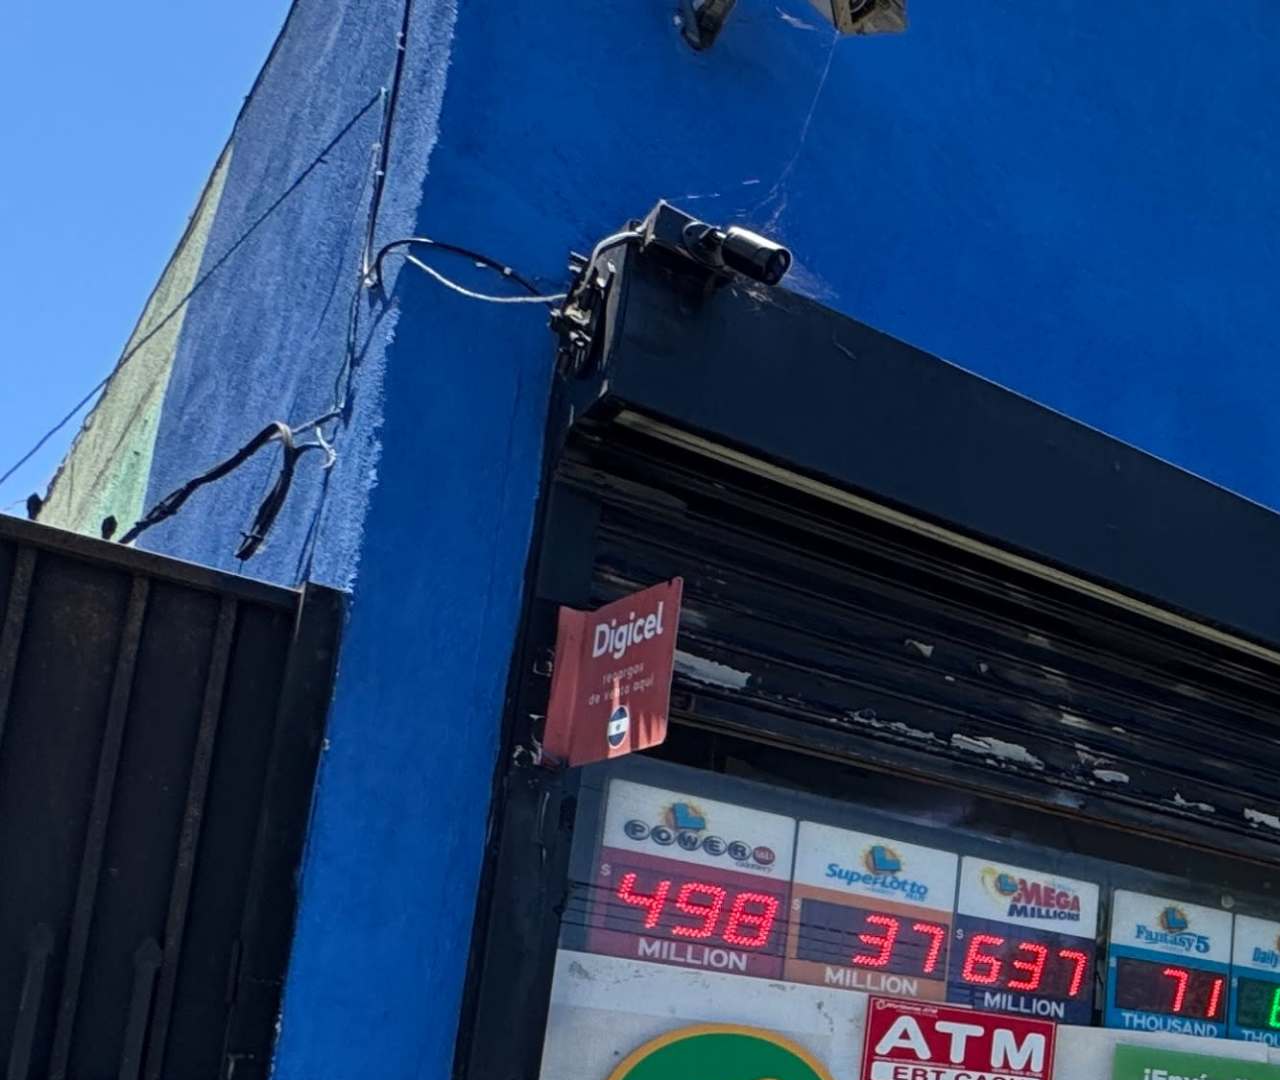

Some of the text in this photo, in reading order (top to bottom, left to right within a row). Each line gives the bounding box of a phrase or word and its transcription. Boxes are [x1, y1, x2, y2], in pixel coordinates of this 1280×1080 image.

[592, 601, 663, 660] Digicel
[825, 863, 928, 897] SuperLotto
[1012, 878, 1080, 911] MEGA
[618, 872, 779, 948] 498
[1007, 904, 1080, 921] MILLIONS
[637, 937, 748, 971] MILLION
[852, 914, 945, 974] 37
[1135, 924, 1196, 951] Fantasy
[825, 967, 918, 995] MILLION
[961, 934, 1088, 997] 637
[984, 991, 1065, 1018] MILLION
[1164, 968, 1223, 1018] 71
[1121, 1012, 1218, 1038] THOUSAND
[875, 1014, 1046, 1074] ATM
